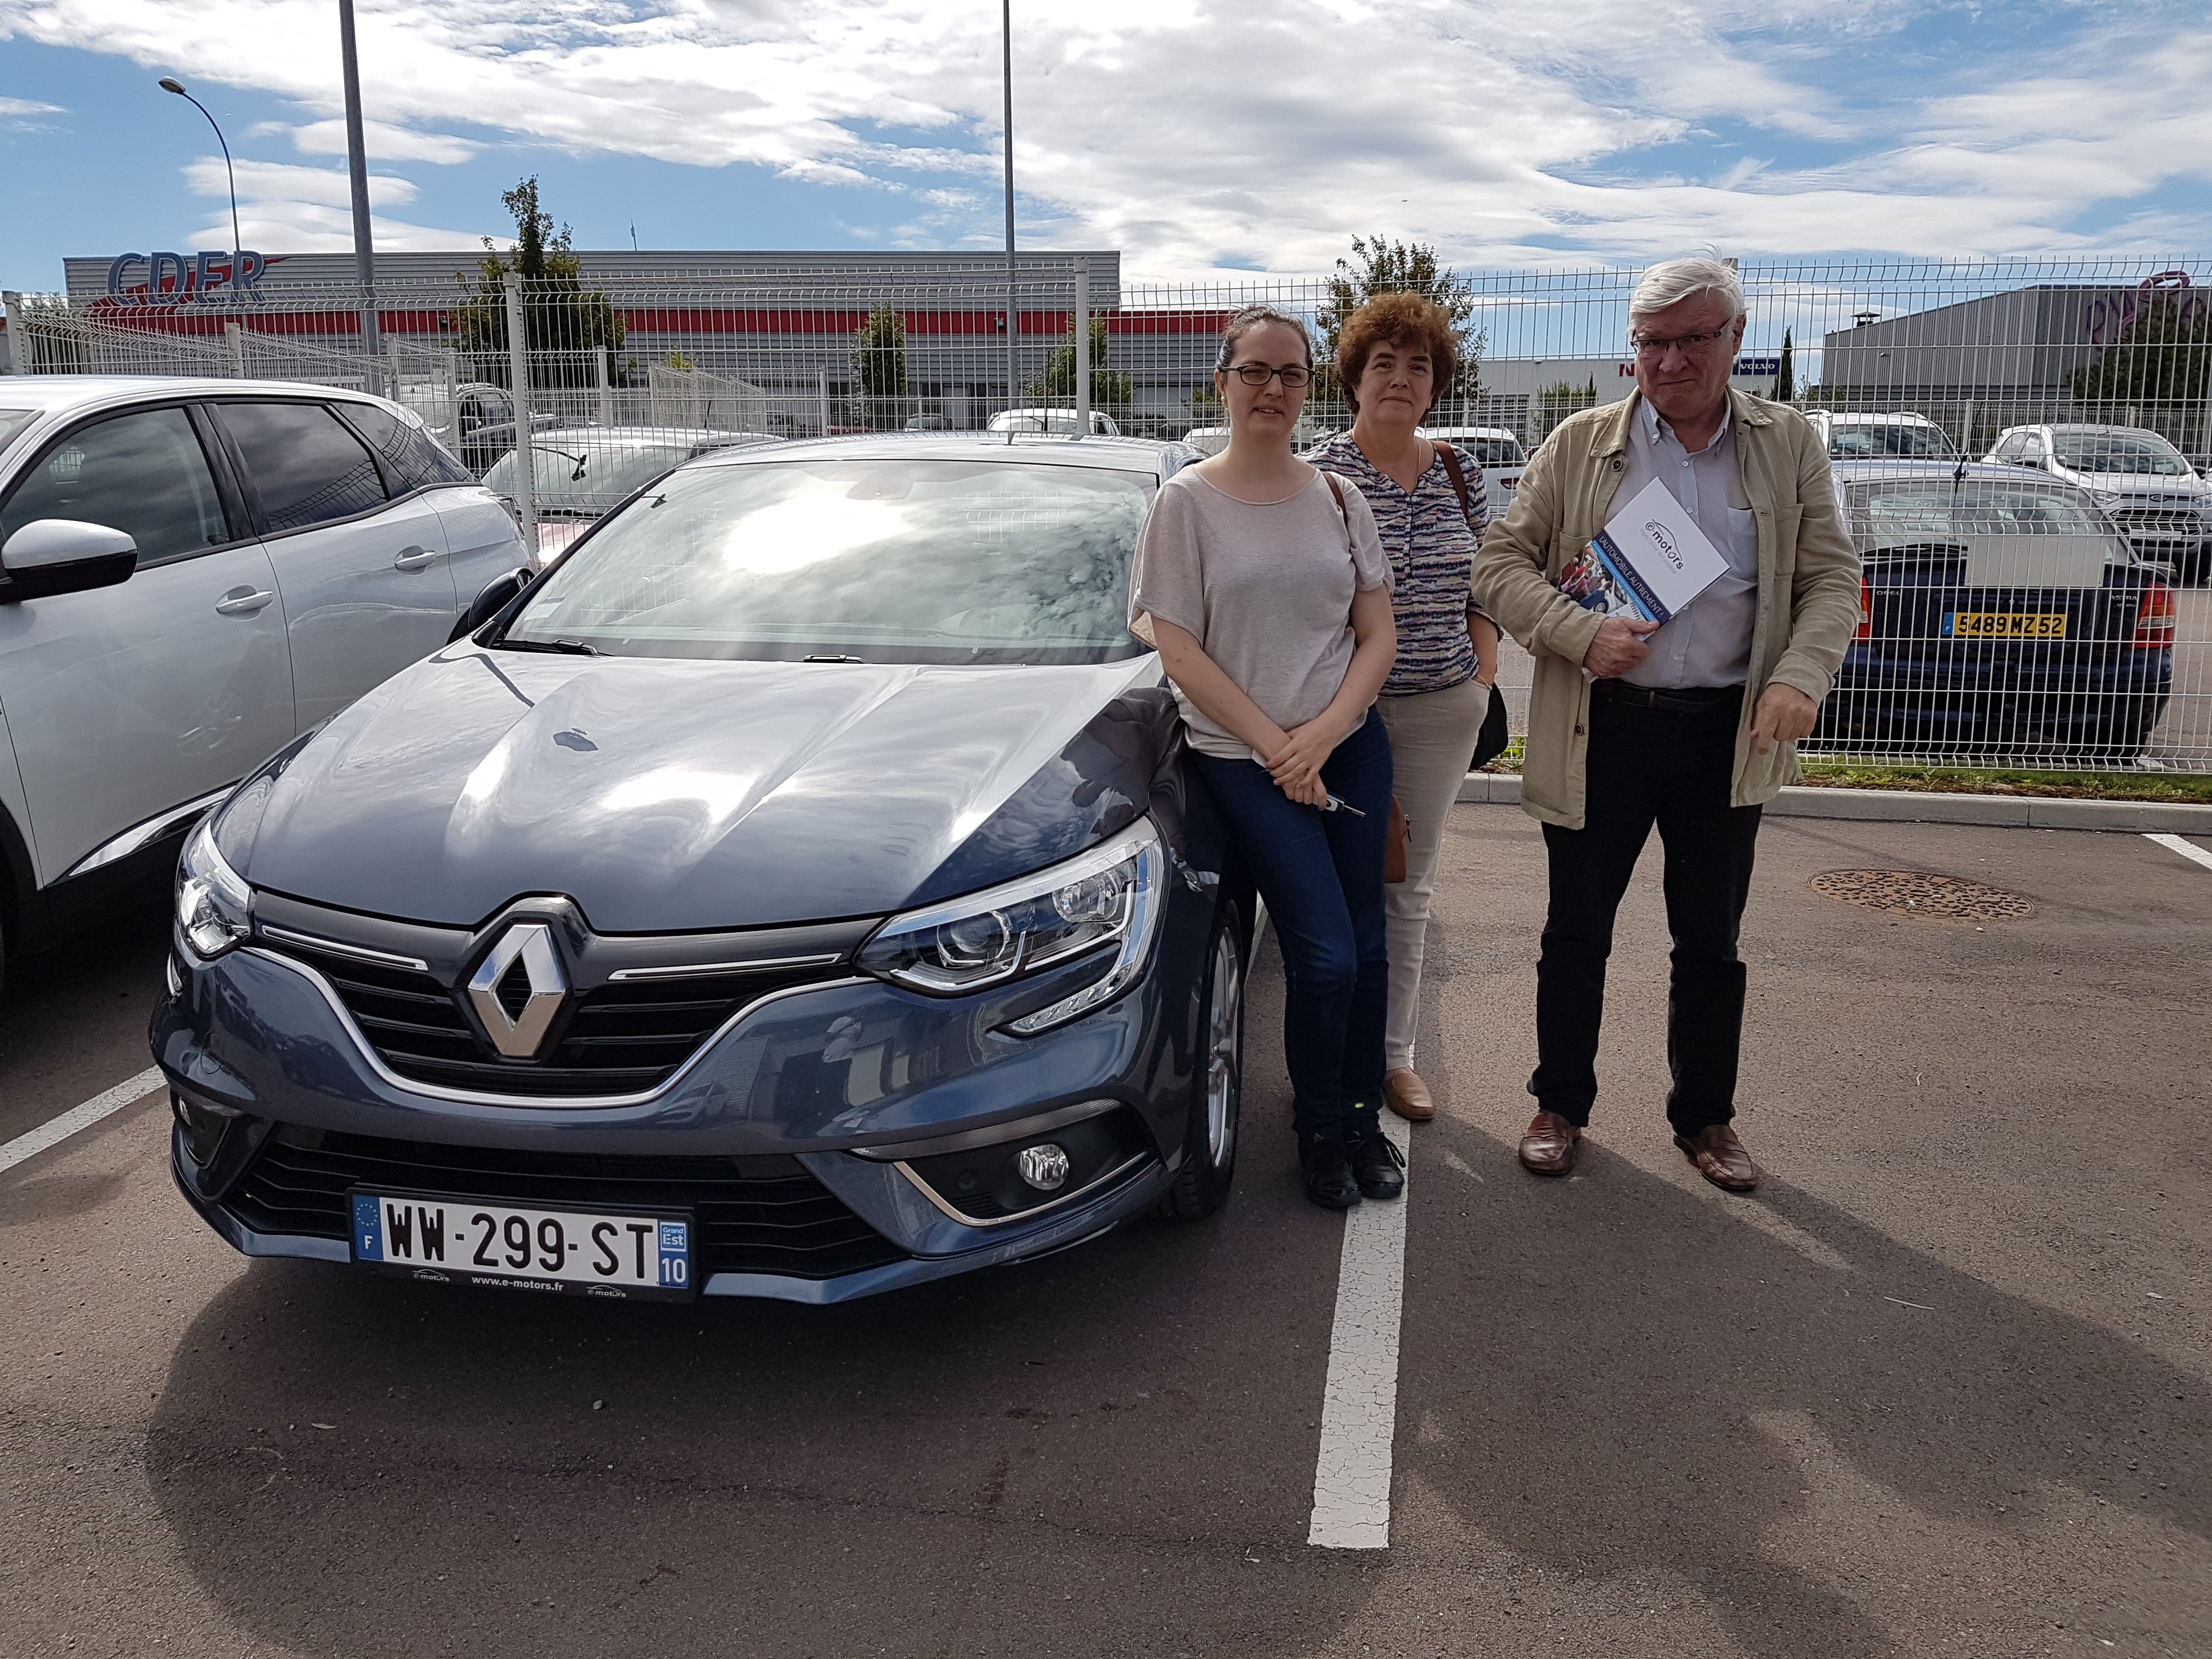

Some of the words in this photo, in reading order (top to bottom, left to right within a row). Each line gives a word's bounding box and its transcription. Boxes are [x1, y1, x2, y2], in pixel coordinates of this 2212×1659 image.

[107, 250, 266, 306] CDER
[1599, 535, 1633, 578] L'AUTOMOBILE
[1629, 577, 1662, 615] AUTREMENT
[1958, 616, 2007, 633] 5489
[2010, 616, 2035, 634] MZ
[2038, 617, 2063, 634] 52
[364, 1235, 373, 1249] F
[386, 1203, 653, 1279] WW-299-ST
[663, 1233, 684, 1246] Est
[662, 1257, 686, 1283] 10
[471, 1277, 564, 1291] www.e-motors.fr
